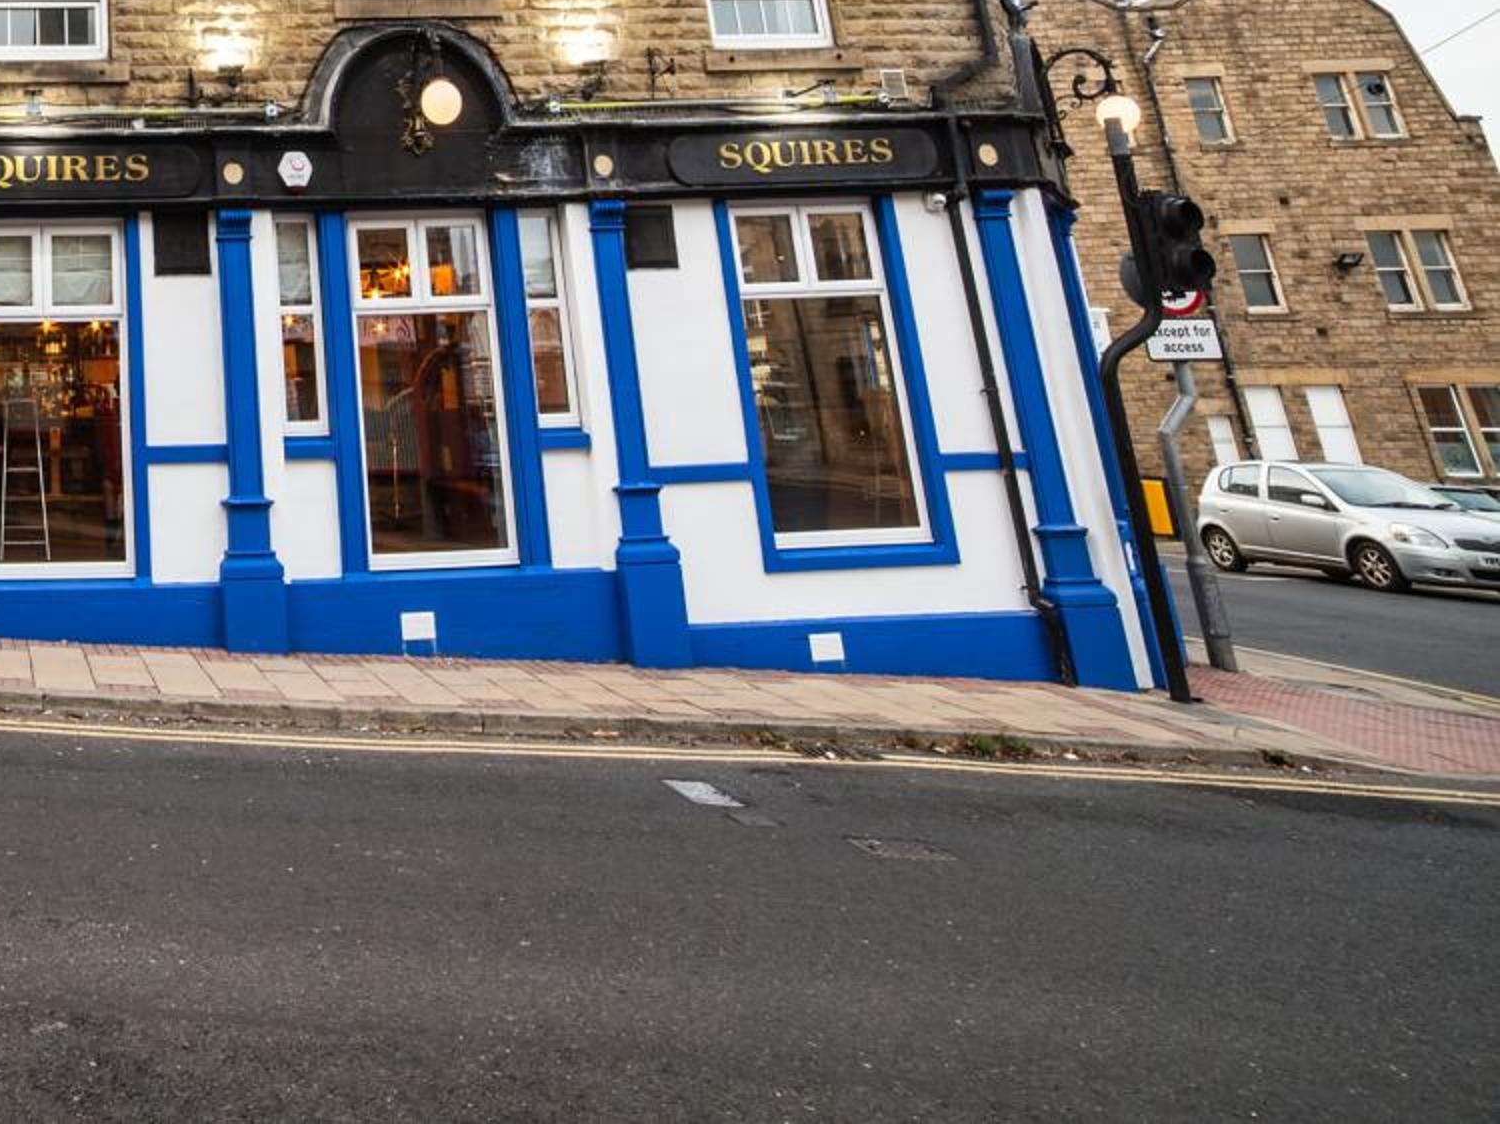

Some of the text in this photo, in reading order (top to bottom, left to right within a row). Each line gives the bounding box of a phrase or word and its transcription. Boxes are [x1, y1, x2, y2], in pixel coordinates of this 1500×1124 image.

[717, 137, 894, 173] SQUIRES
[1157, 325, 1211, 338] xcept for
[1164, 342, 1205, 353] access
